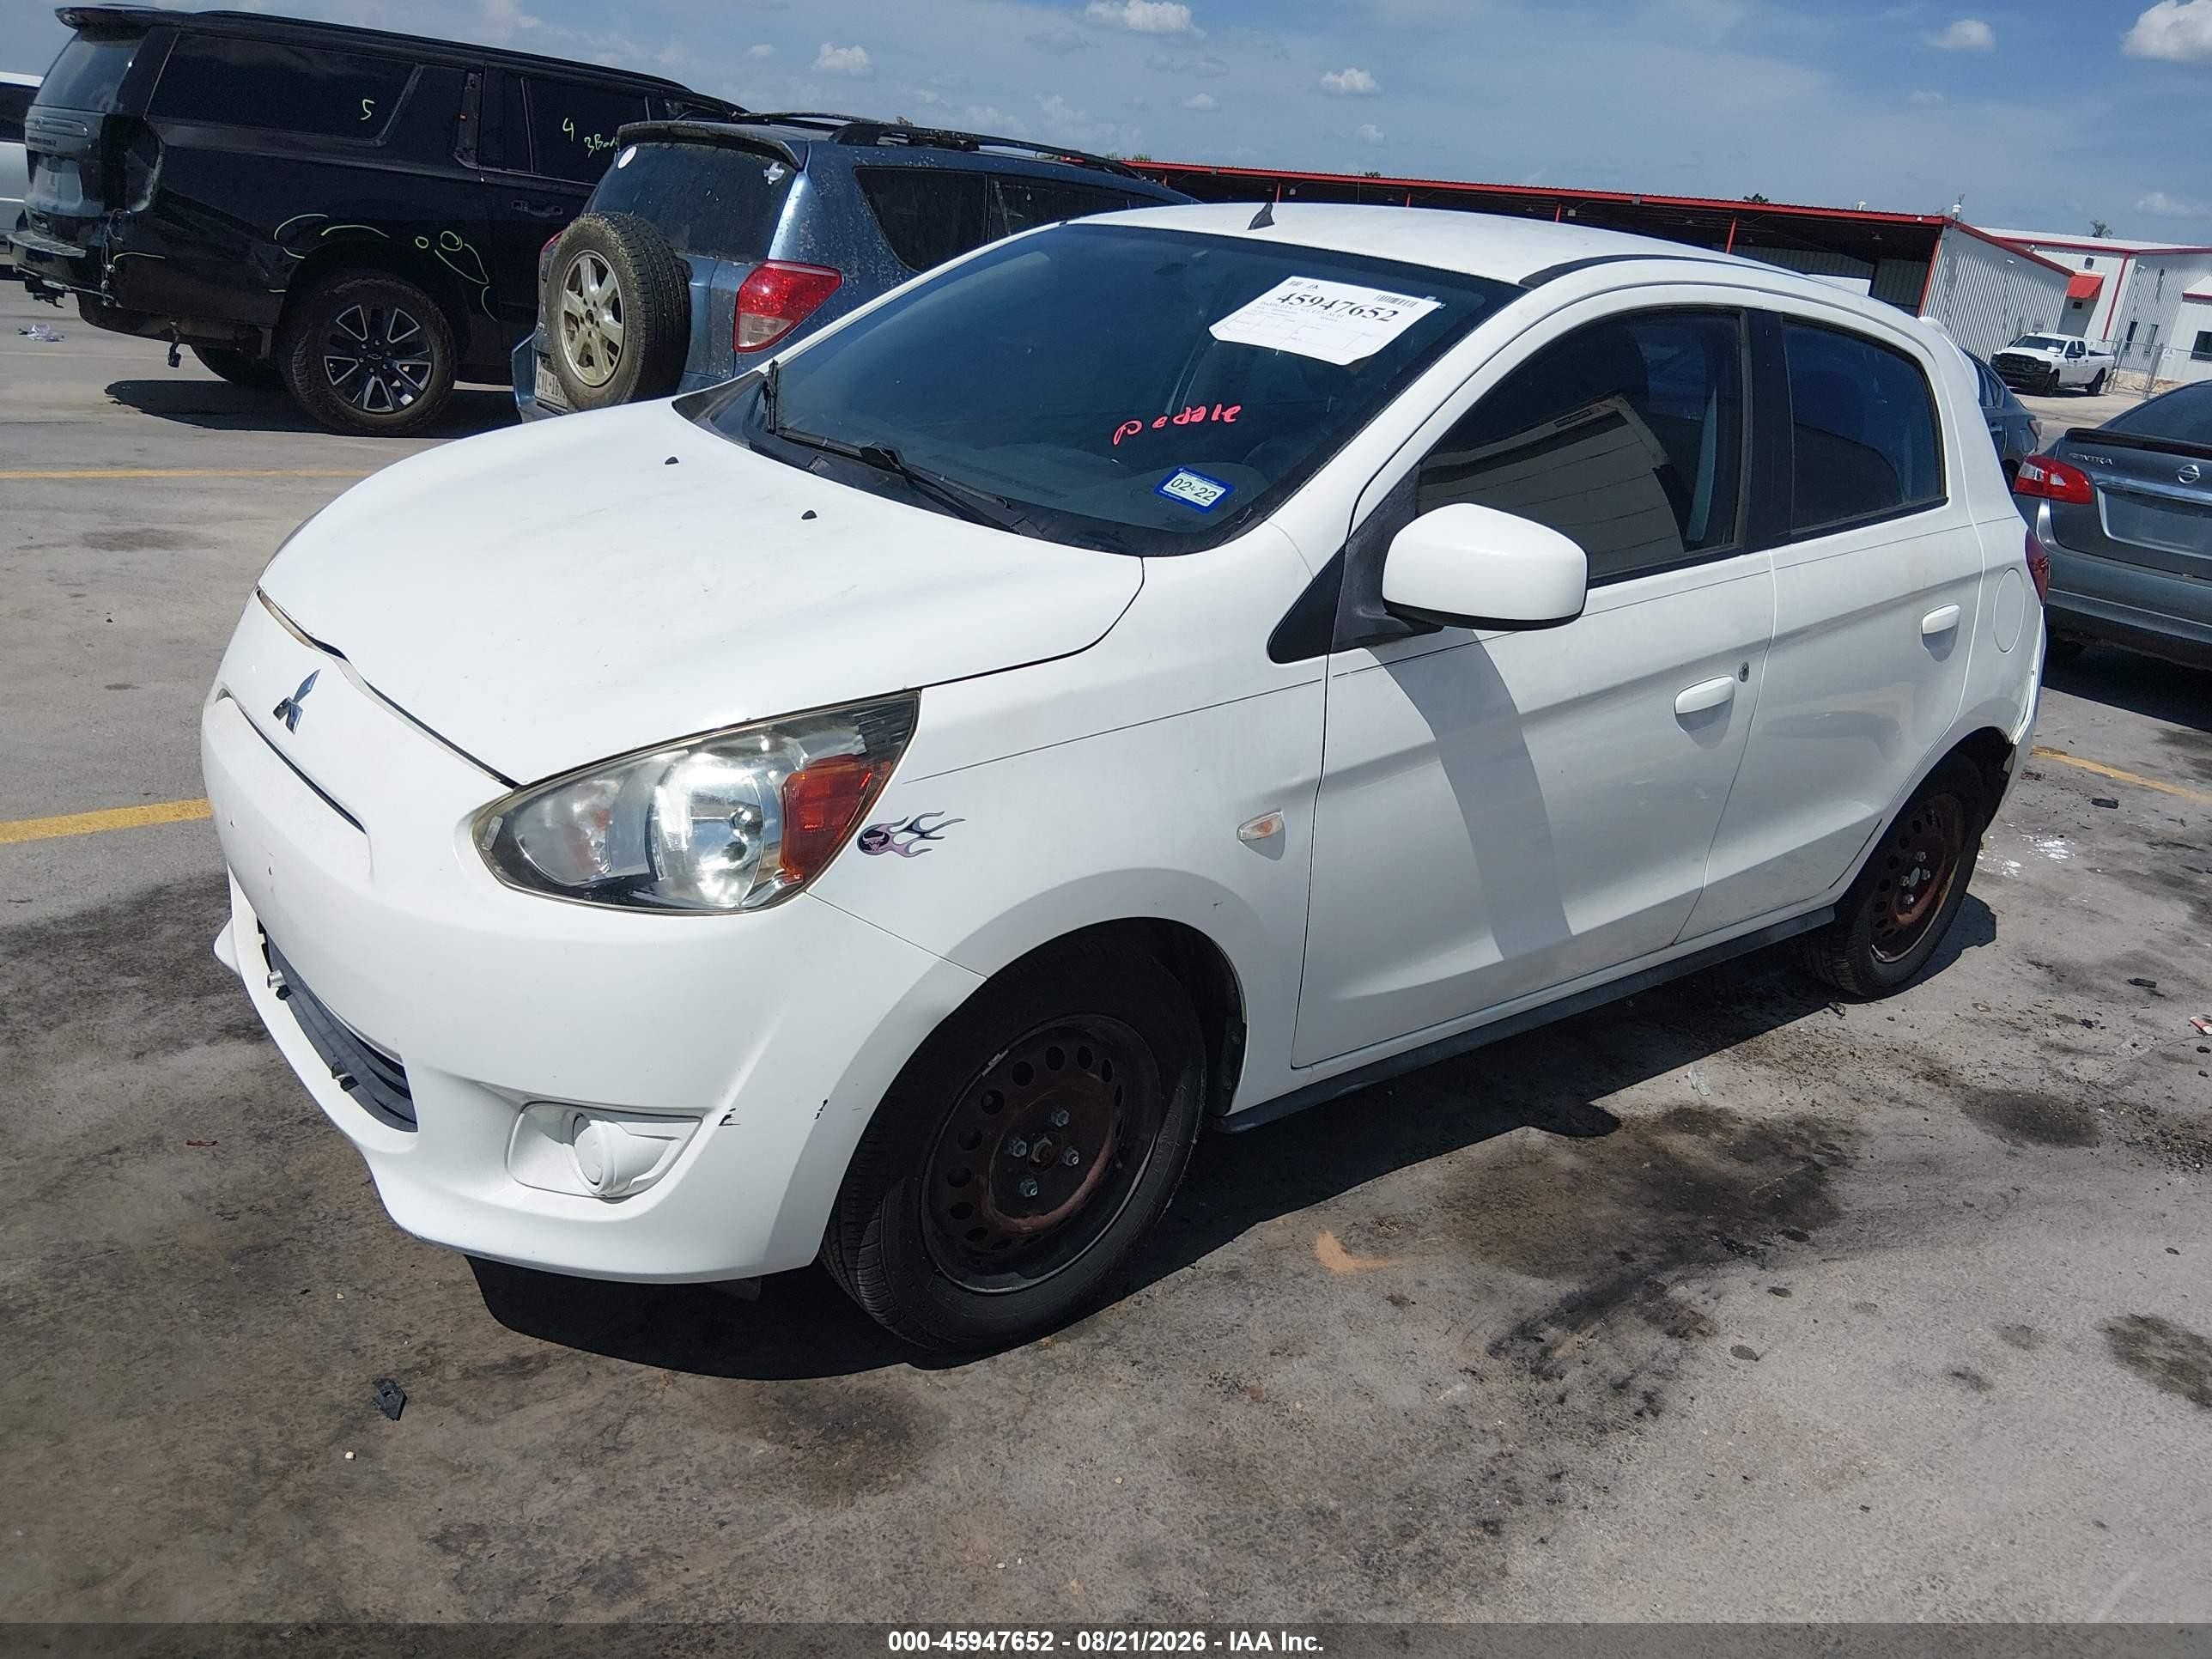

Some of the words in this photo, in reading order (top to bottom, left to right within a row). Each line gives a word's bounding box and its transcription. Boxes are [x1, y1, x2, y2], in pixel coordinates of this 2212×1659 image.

[562, 117, 576, 143] 4
[1276, 291, 1400, 323] 45947652
[1170, 477, 1193, 492] 02
[1194, 486, 1218, 501] 22
